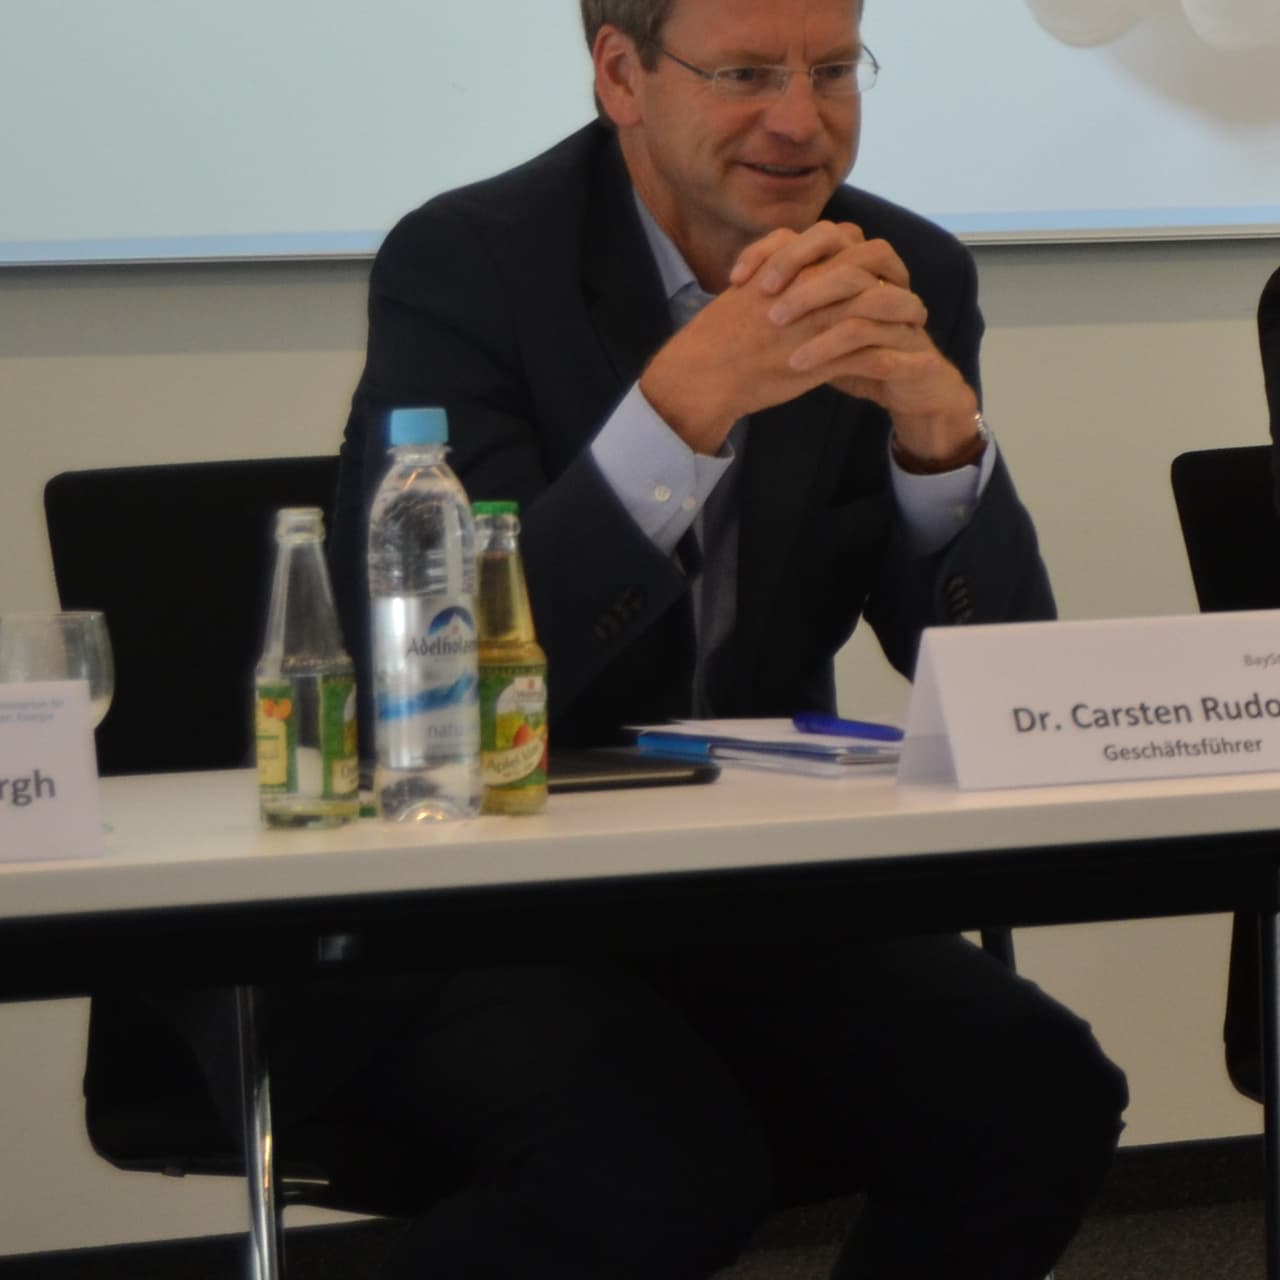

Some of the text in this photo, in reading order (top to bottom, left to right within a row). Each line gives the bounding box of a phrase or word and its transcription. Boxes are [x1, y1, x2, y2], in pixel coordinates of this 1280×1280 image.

[1012, 706, 1063, 734] Dr.
[1071, 699, 1193, 730] Carsten
[1103, 735, 1263, 763] Geschäftsführer
